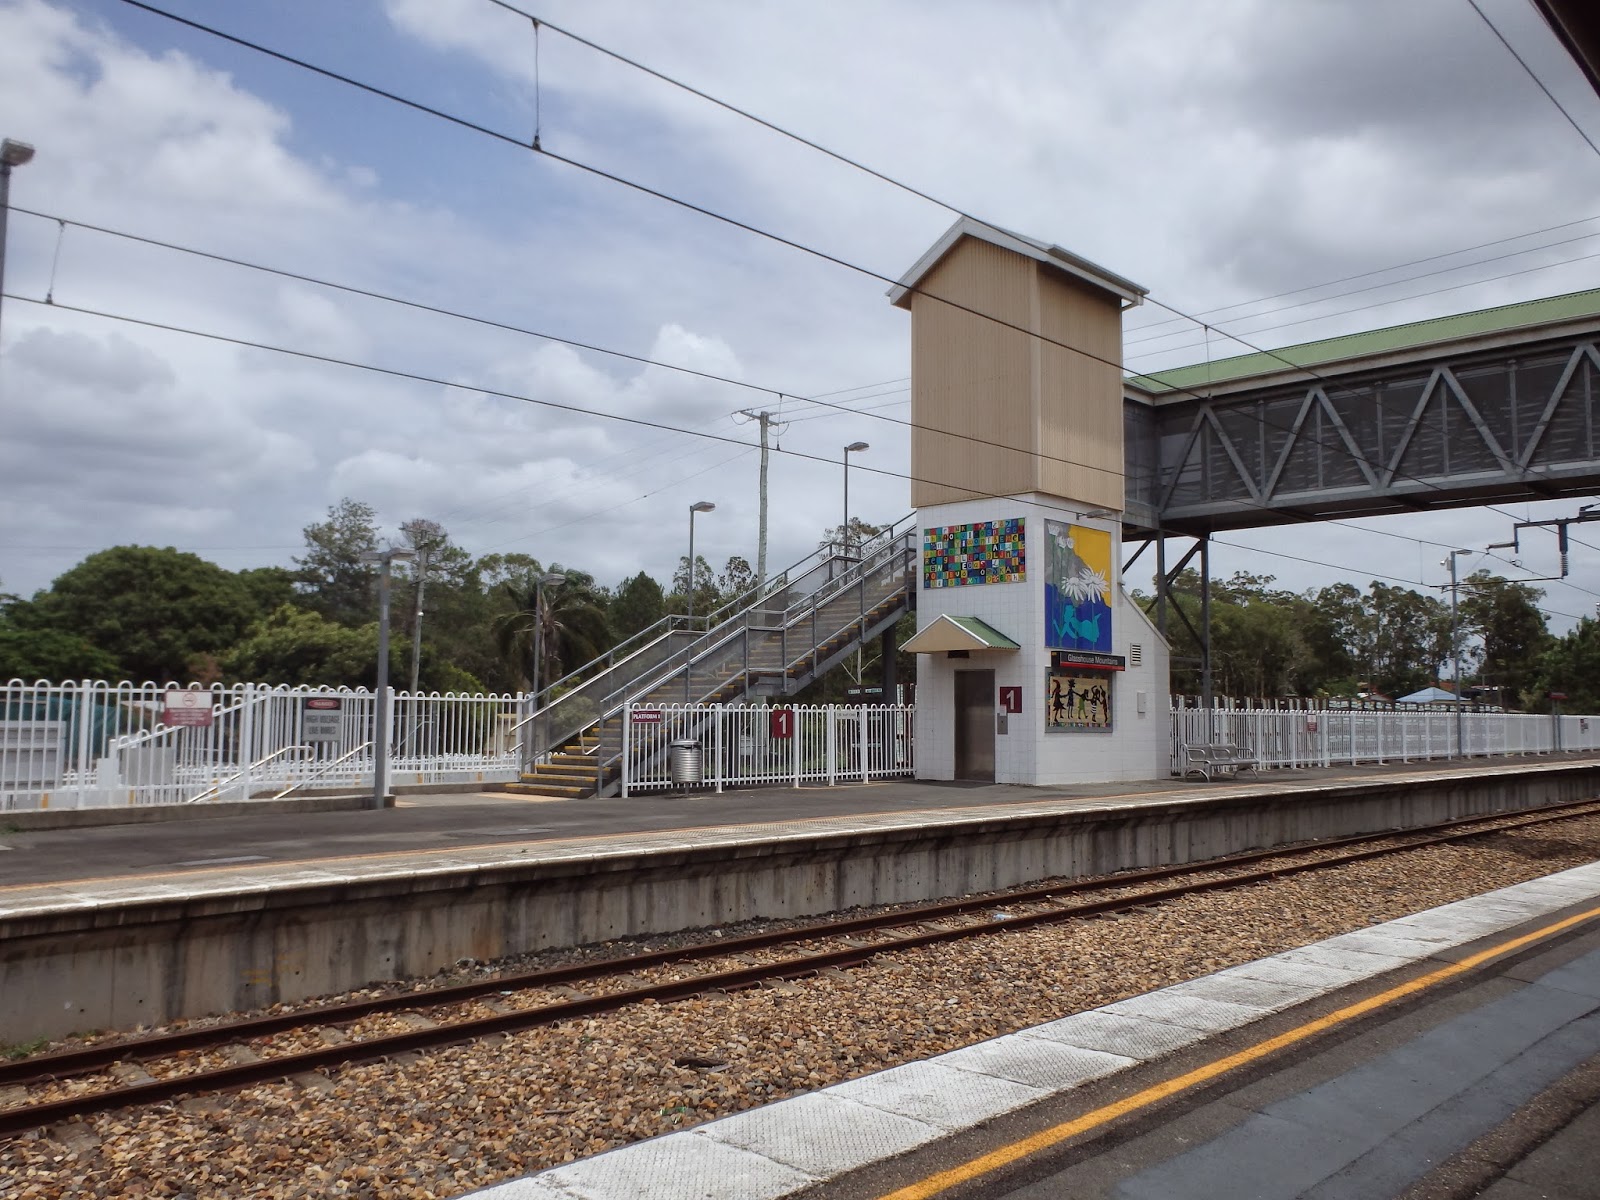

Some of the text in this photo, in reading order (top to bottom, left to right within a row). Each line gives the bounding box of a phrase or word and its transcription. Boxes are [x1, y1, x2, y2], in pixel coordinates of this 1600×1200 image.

[1067, 653, 1118, 666] Glasshouse Mountains
[1006, 690, 1014, 710] 1
[779, 713, 786, 735] 1
